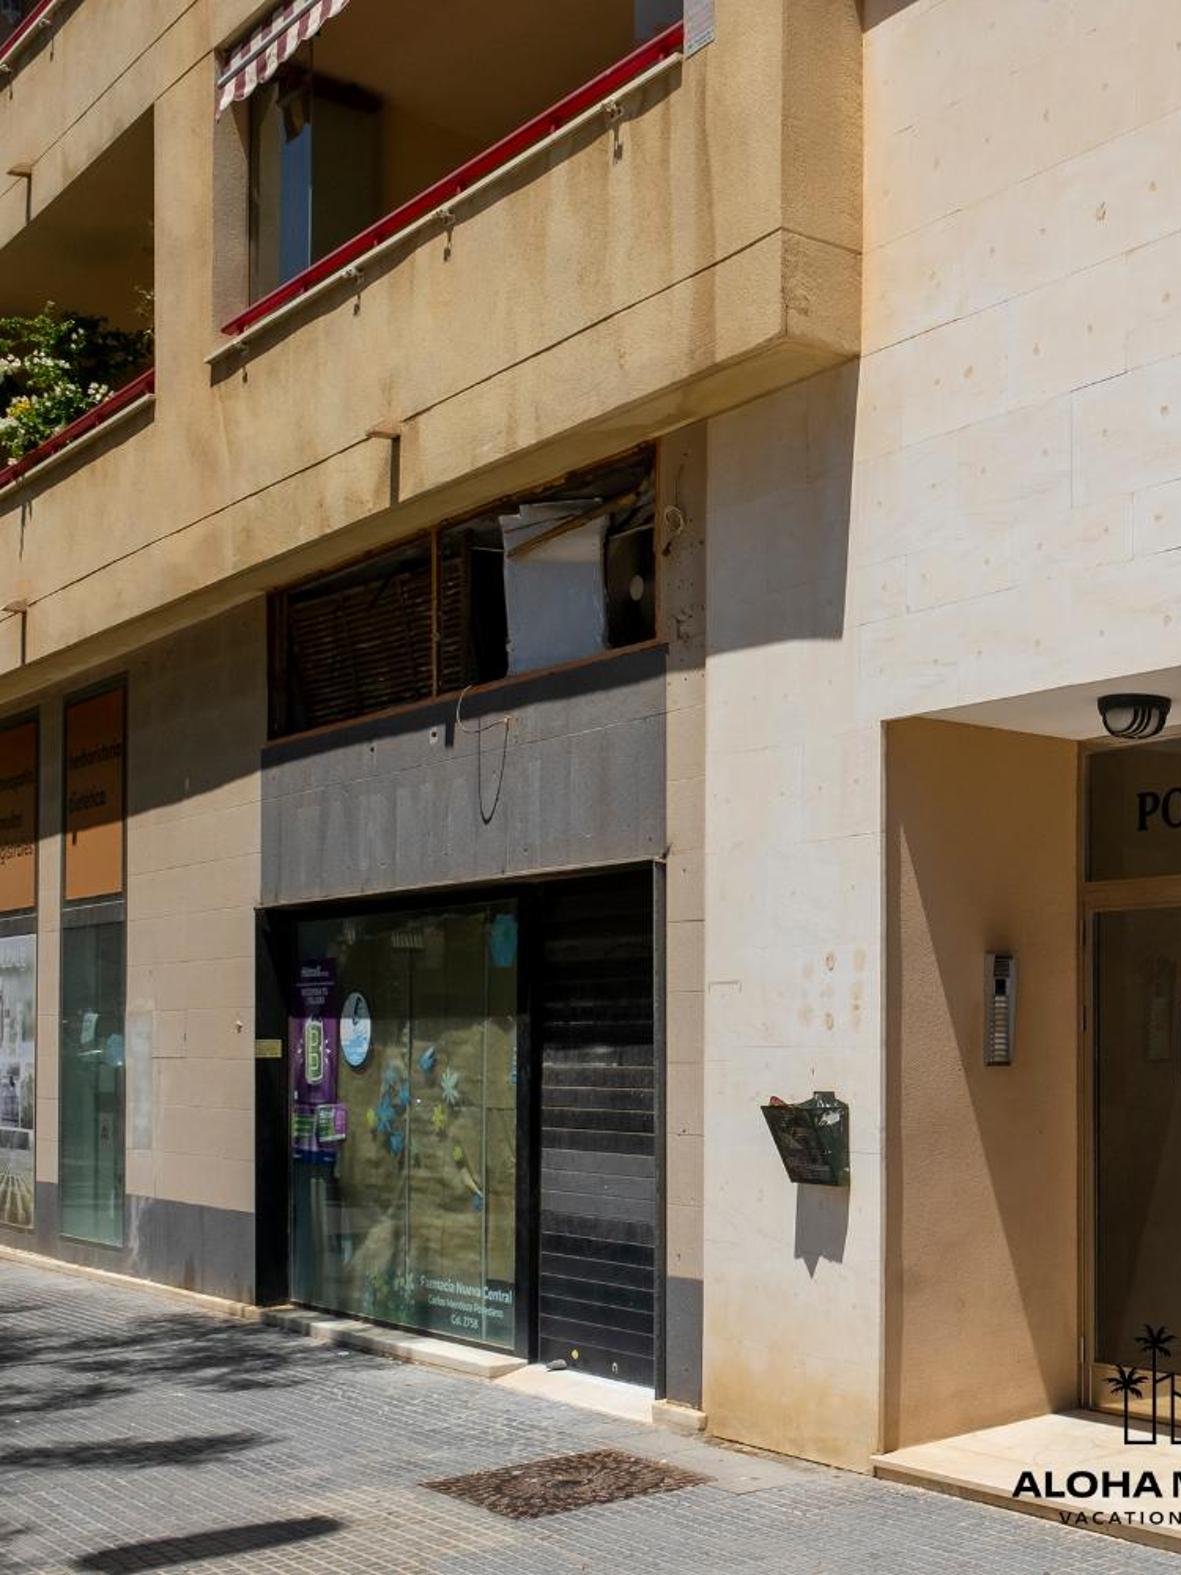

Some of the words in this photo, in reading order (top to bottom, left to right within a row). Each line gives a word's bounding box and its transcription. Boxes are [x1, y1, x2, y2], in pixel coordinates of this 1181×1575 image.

[420, 1274, 454, 1293] Farmacia
[455, 1280, 481, 1298] Nueva
[481, 1285, 513, 1304] Central
